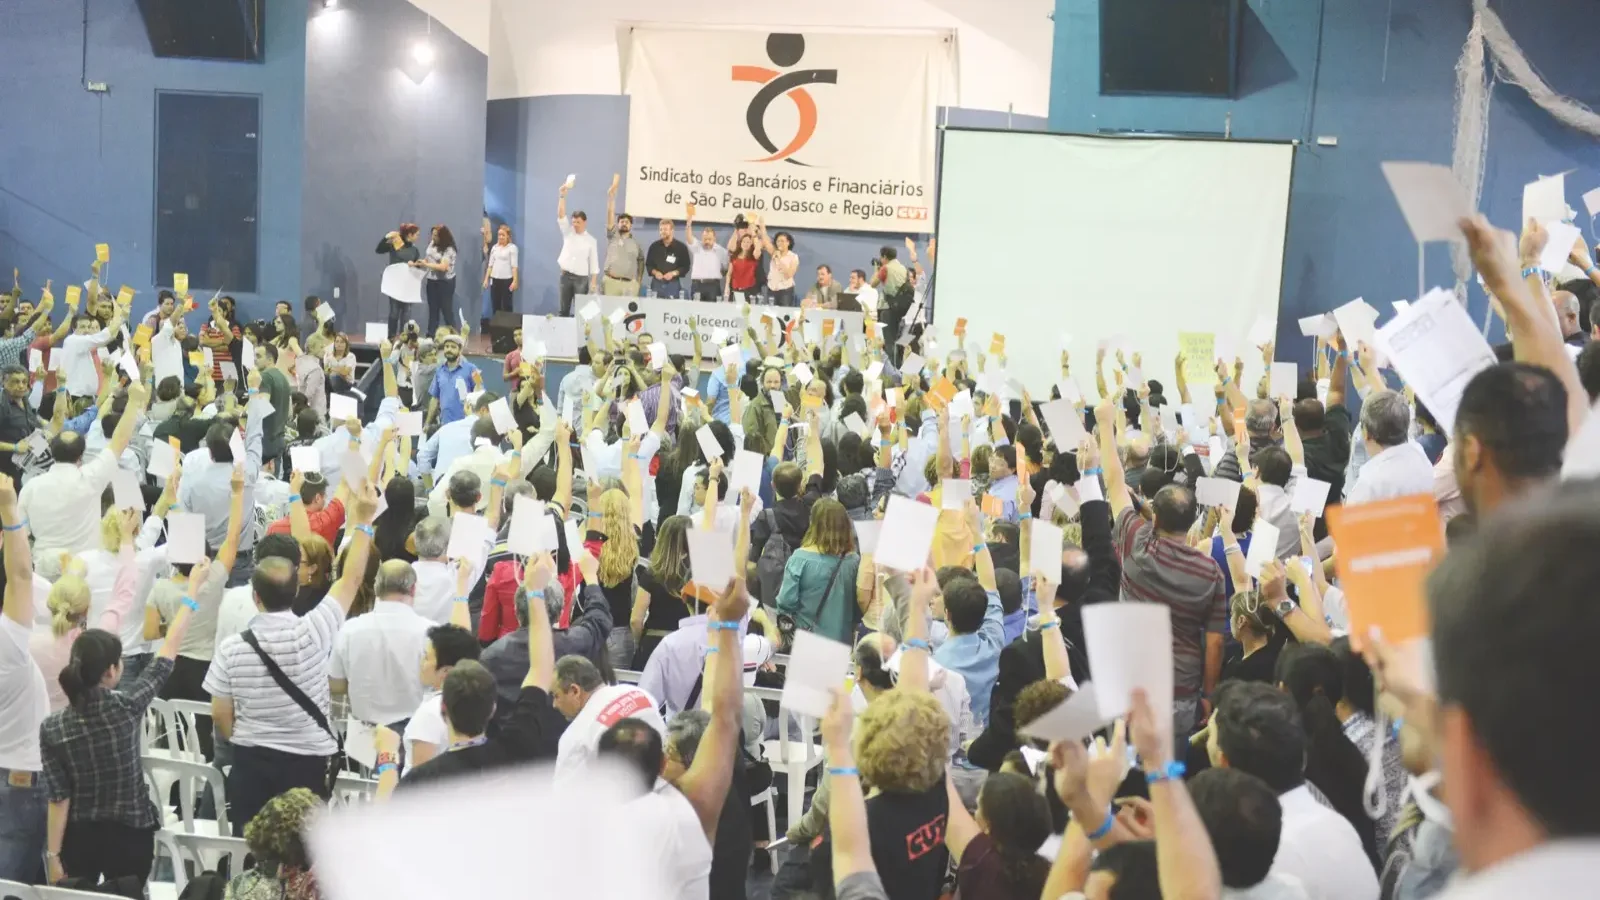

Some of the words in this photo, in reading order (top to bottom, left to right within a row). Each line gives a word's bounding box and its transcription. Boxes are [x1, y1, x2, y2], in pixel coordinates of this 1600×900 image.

[639, 165, 703, 184] Sindicato
[708, 170, 732, 186] dos
[737, 171, 807, 191] Bancários
[813, 180, 822, 192] e
[828, 176, 924, 197] Financiários
[664, 189, 682, 204] de
[690, 190, 717, 207] São
[772, 195, 824, 213] Osasco
[829, 202, 838, 214] e
[843, 199, 894, 220] Região
[896, 205, 928, 220] CUT
[663, 312, 741, 328] Forlecend
